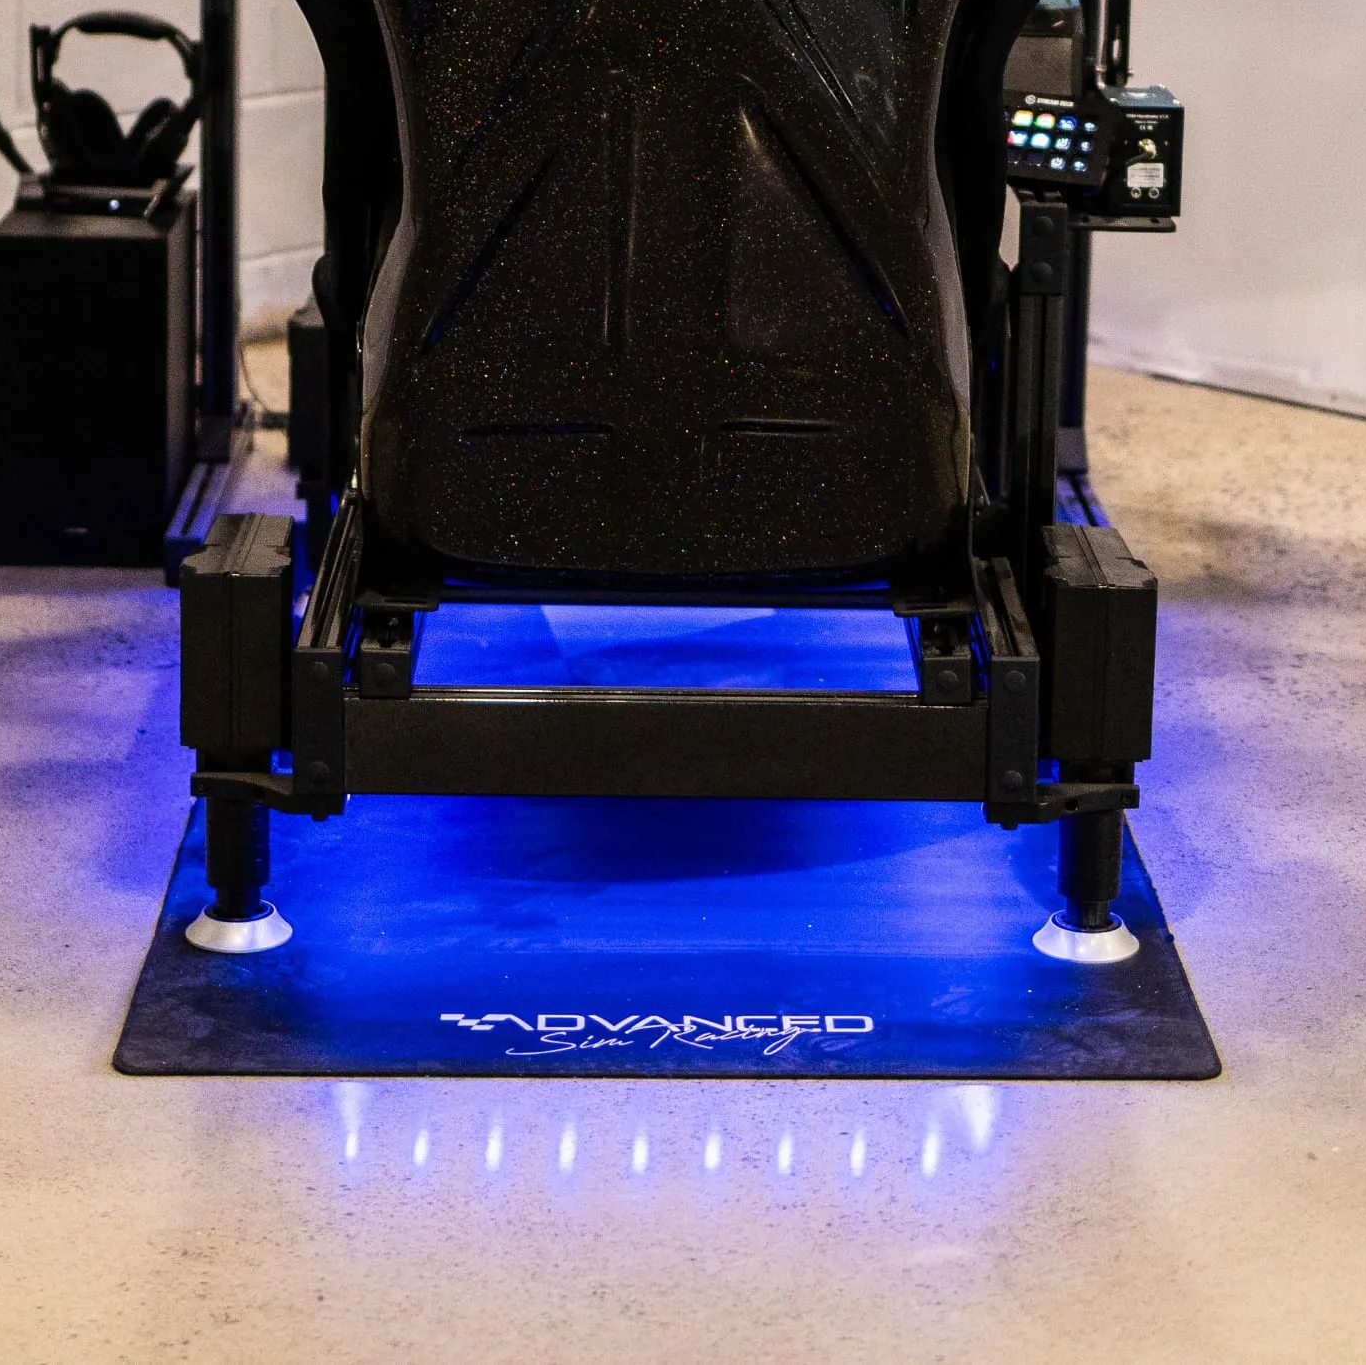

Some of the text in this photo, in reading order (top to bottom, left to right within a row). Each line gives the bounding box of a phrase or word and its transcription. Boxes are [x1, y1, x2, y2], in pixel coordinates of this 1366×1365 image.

[440, 1013, 874, 1033] ADVANCED
[505, 1022, 817, 1056] Sim Racing
